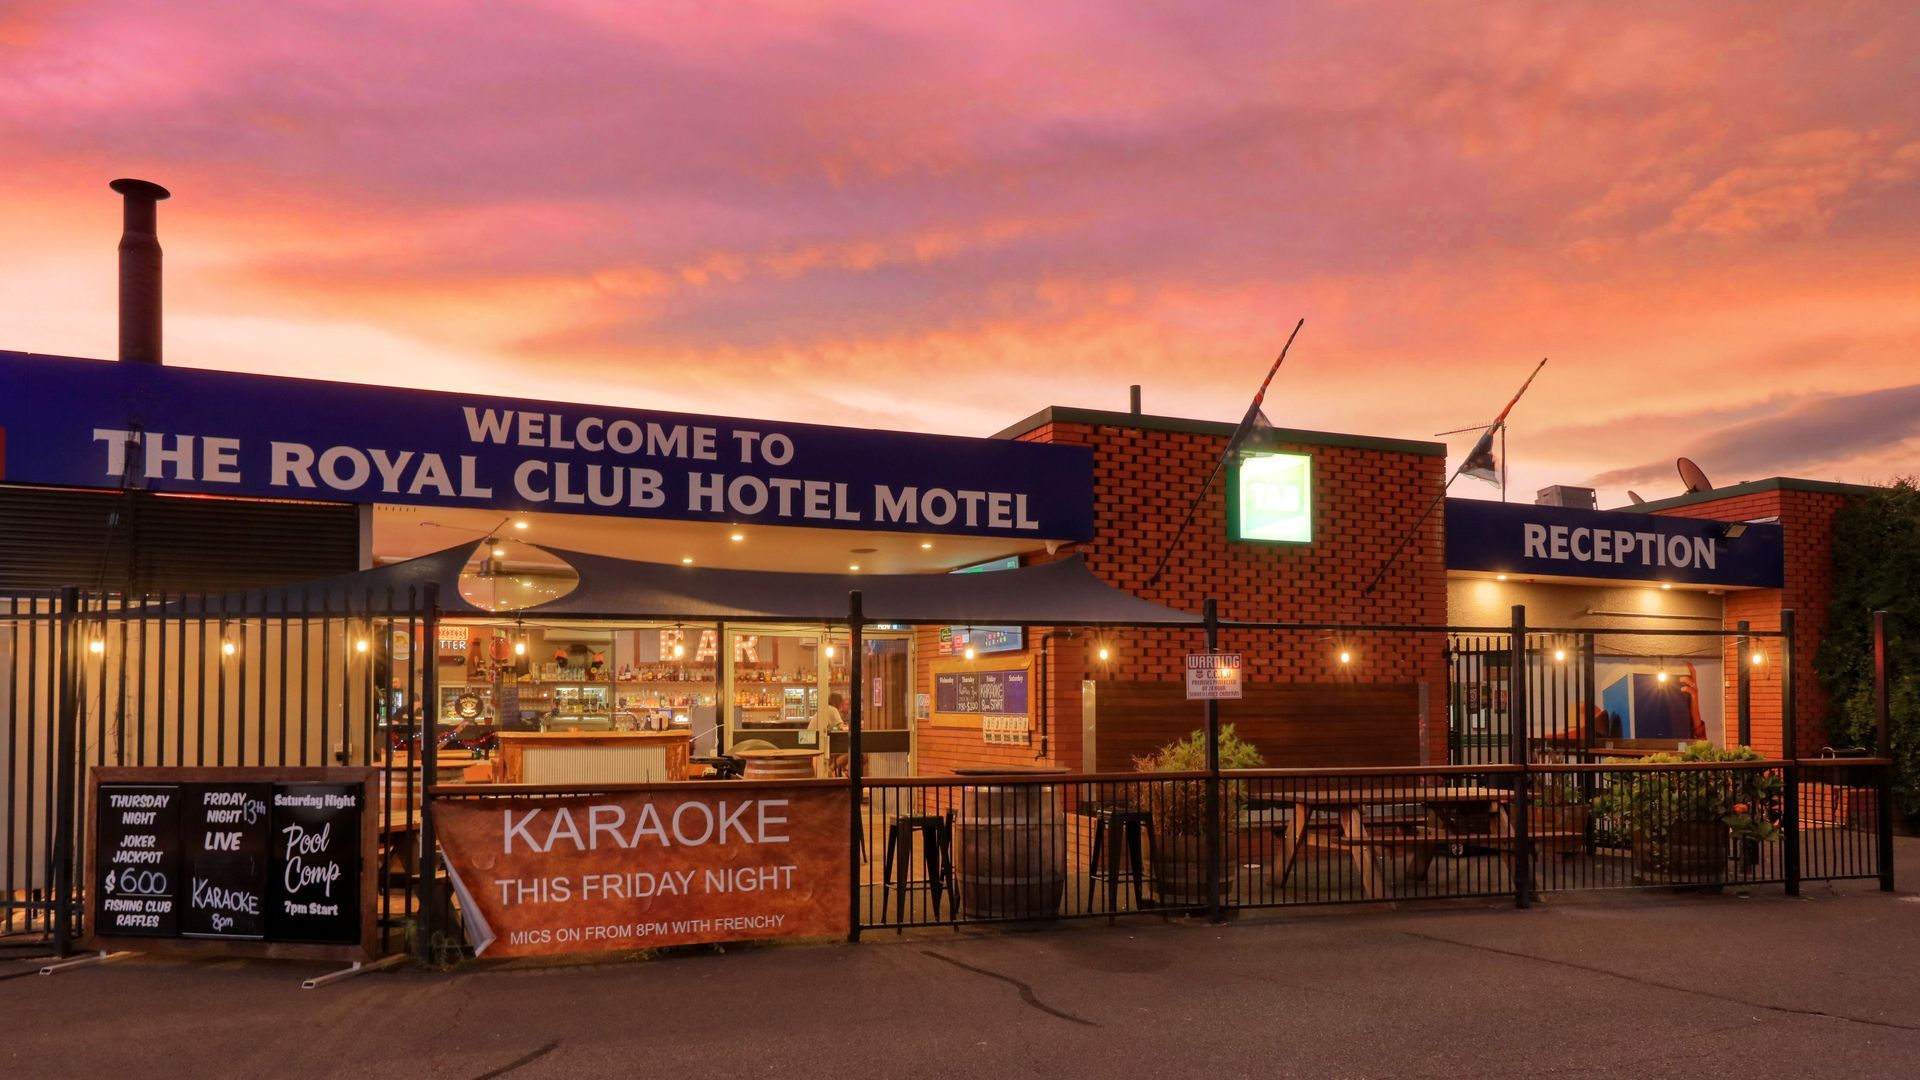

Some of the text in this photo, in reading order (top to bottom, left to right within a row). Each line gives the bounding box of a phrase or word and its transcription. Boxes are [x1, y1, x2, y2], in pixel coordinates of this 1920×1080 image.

[463, 406, 795, 466] WELCOME TO
[93, 428, 1039, 530] THE ROYAL CLUB HOTEL MOTEL
[1523, 523, 1716, 570] RECEPTION
[440, 640, 467, 650] TTER
[659, 629, 759, 663] BAR
[1188, 655, 1240, 669] WARNING
[110, 795, 169, 809] THURSDAY
[203, 792, 246, 806] FRIDAY
[274, 793, 356, 810] Saturday Night
[122, 812, 156, 825] NIGHT
[206, 809, 241, 823] NIGHT
[243, 799, 266, 825] 13th
[503, 799, 790, 854] KARAOKE
[120, 835, 156, 848] JOKER
[204, 832, 243, 851] LIVE
[282, 822, 331, 861] Pool
[112, 850, 163, 864] JACKPOT
[284, 855, 341, 897] Comp
[495, 865, 798, 905] THIS FRIDAY NIGHT
[192, 876, 260, 915] KARAOKE
[104, 899, 172, 913] FISHING CLUB
[284, 901, 339, 916] 7pm Start
[116, 914, 159, 927] RAFFLES
[211, 912, 233, 932] 8pm
[510, 914, 785, 945] MICS ON FROM 8PM WITH FRENCHY
